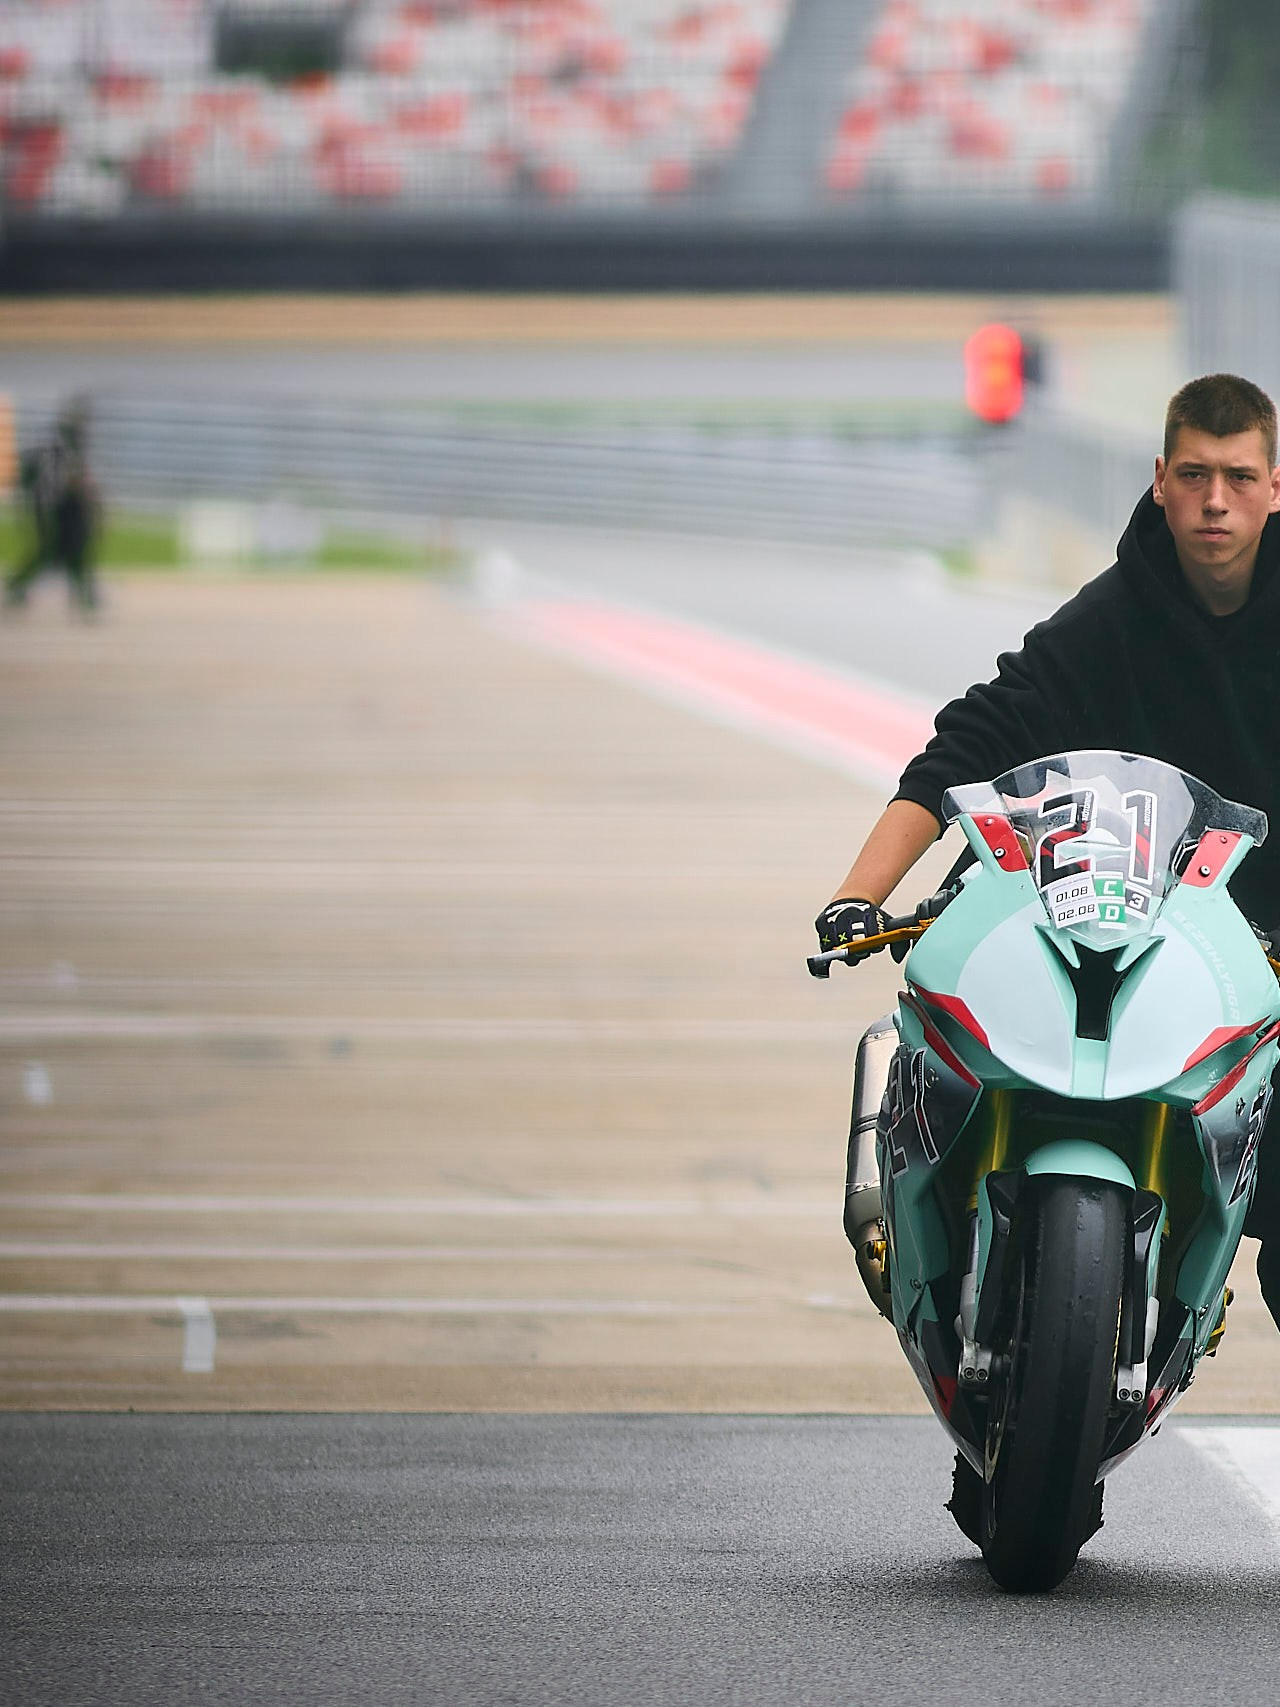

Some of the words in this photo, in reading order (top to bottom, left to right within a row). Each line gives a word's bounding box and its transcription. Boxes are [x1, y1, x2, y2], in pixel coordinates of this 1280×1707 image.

[1038, 786, 1158, 890] 21
[1103, 880, 1117, 895] C
[1128, 893, 1145, 910] 3
[1105, 905, 1120, 920] D
